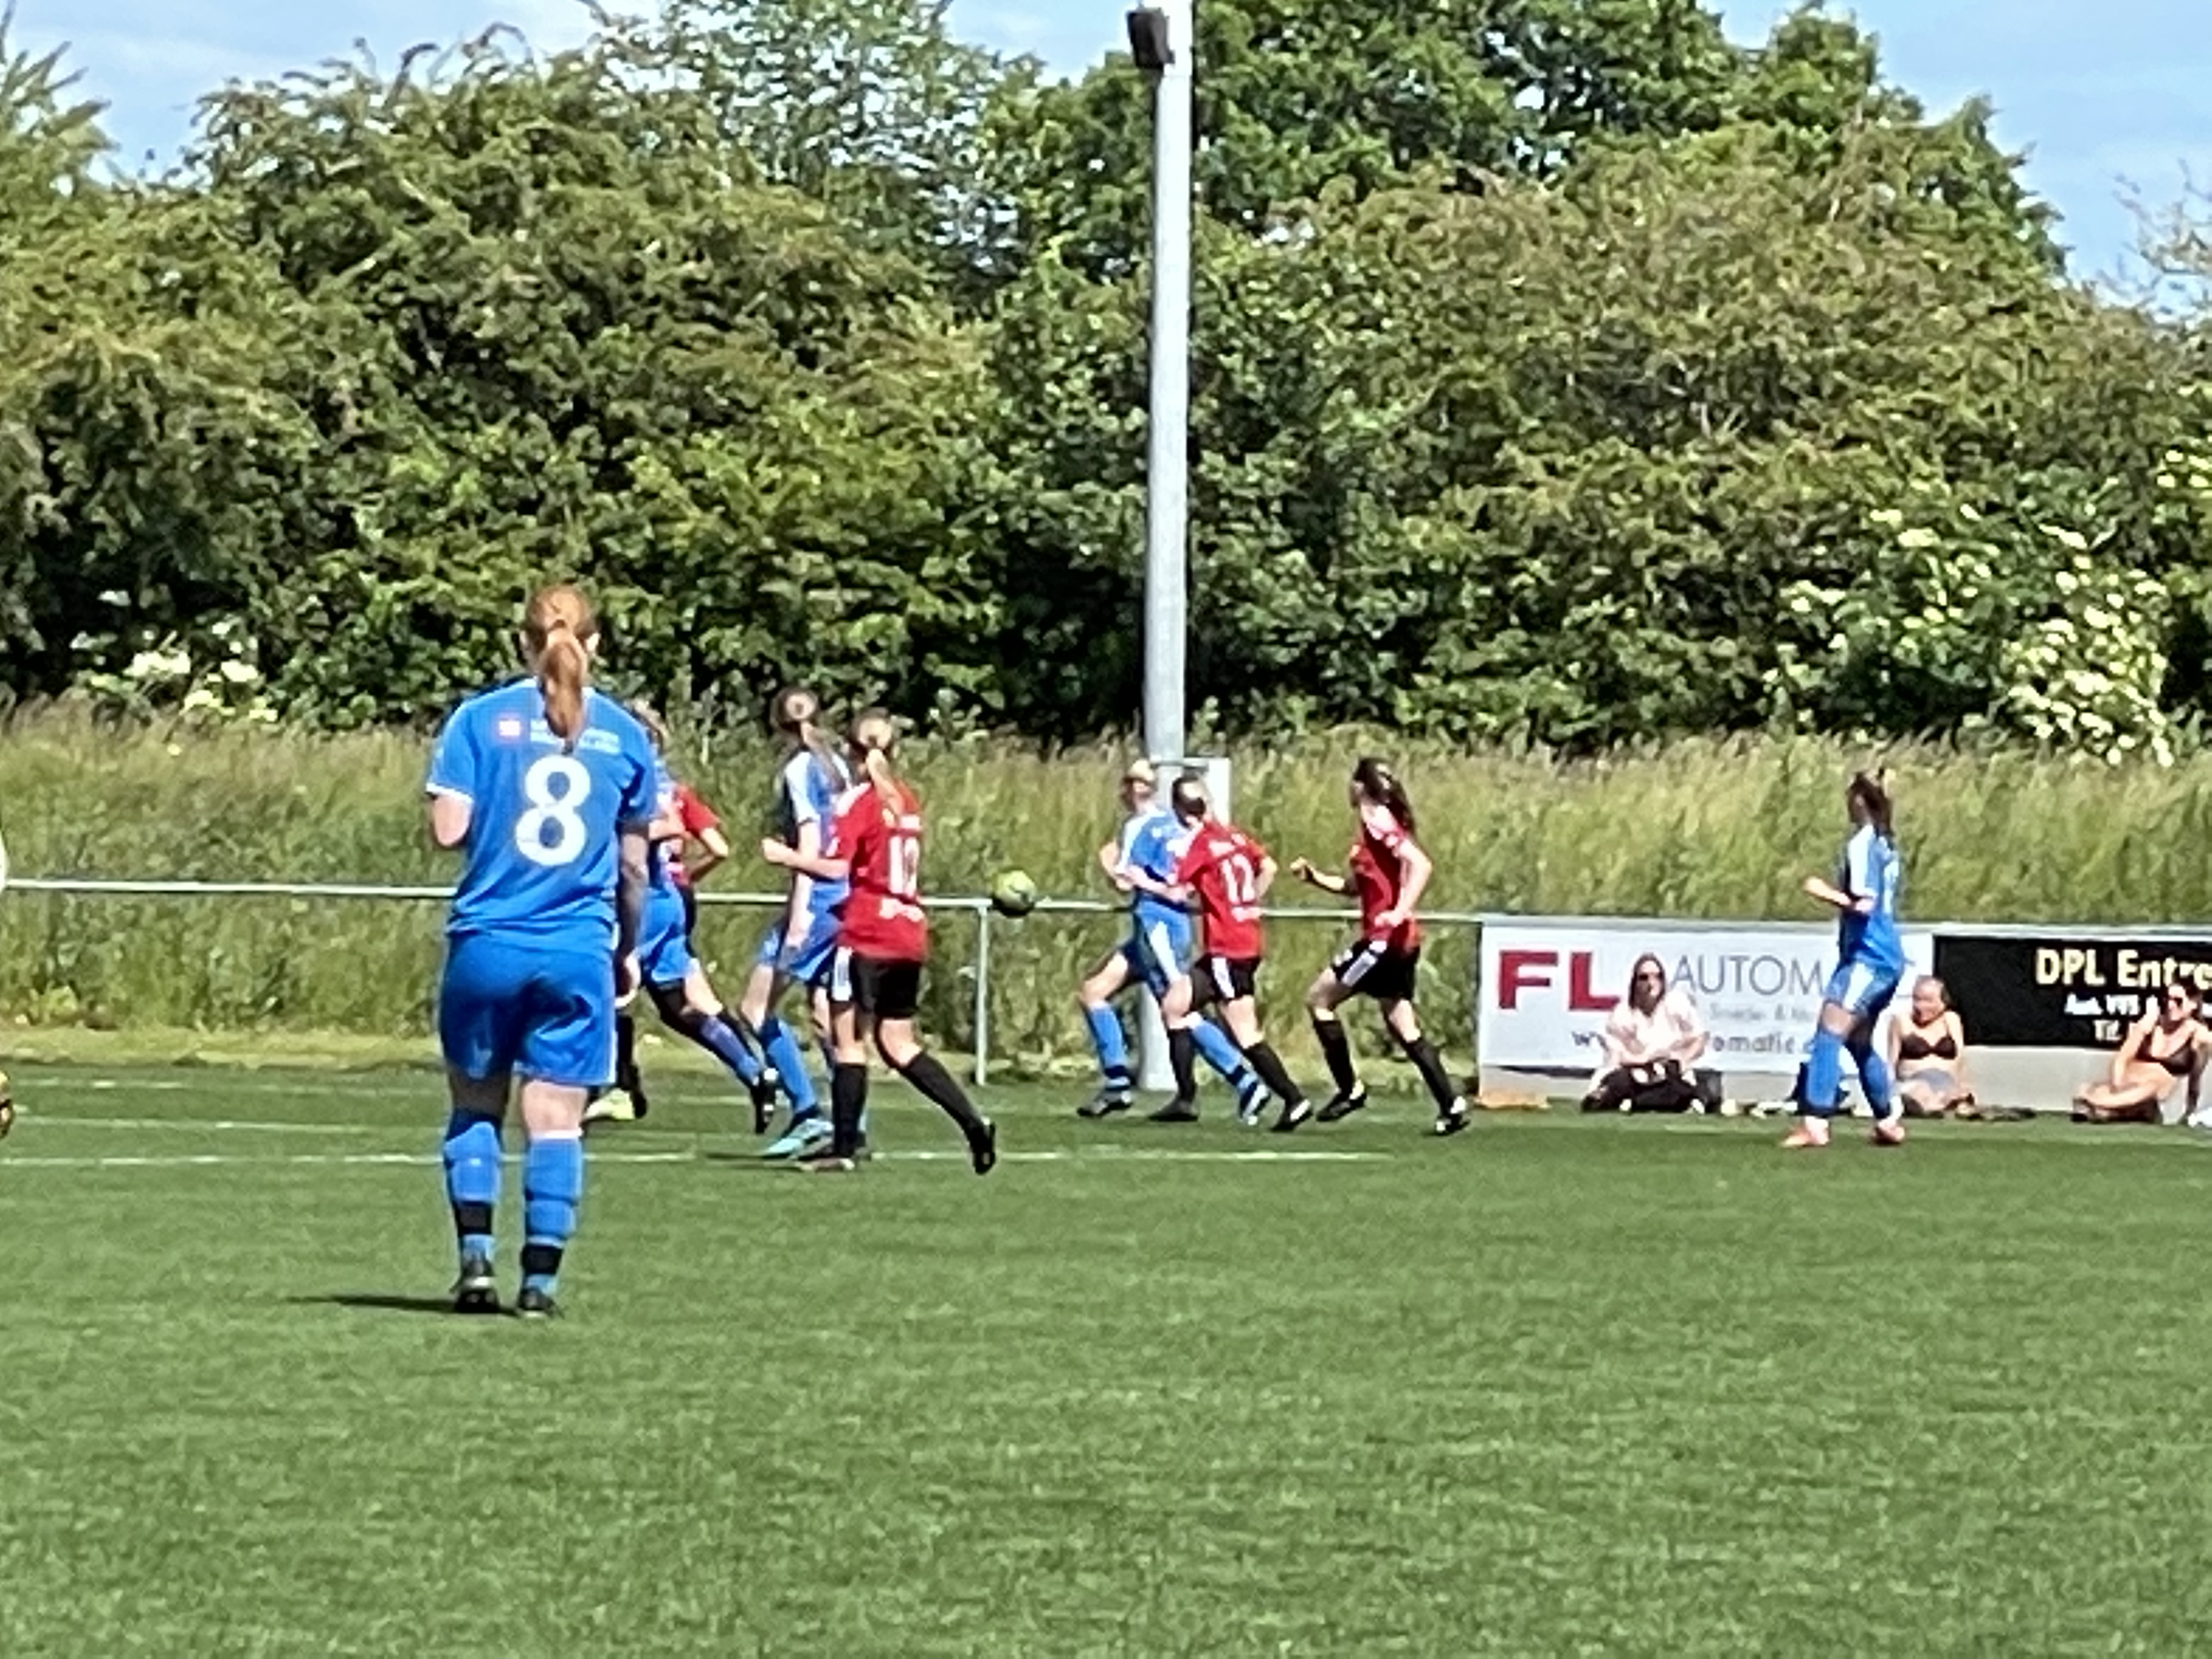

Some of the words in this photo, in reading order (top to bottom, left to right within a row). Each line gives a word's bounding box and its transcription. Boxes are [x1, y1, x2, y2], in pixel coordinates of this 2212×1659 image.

[515, 755, 590, 866] 8
[1498, 950, 1621, 1011] FL
[2036, 948, 2106, 985] DPL
